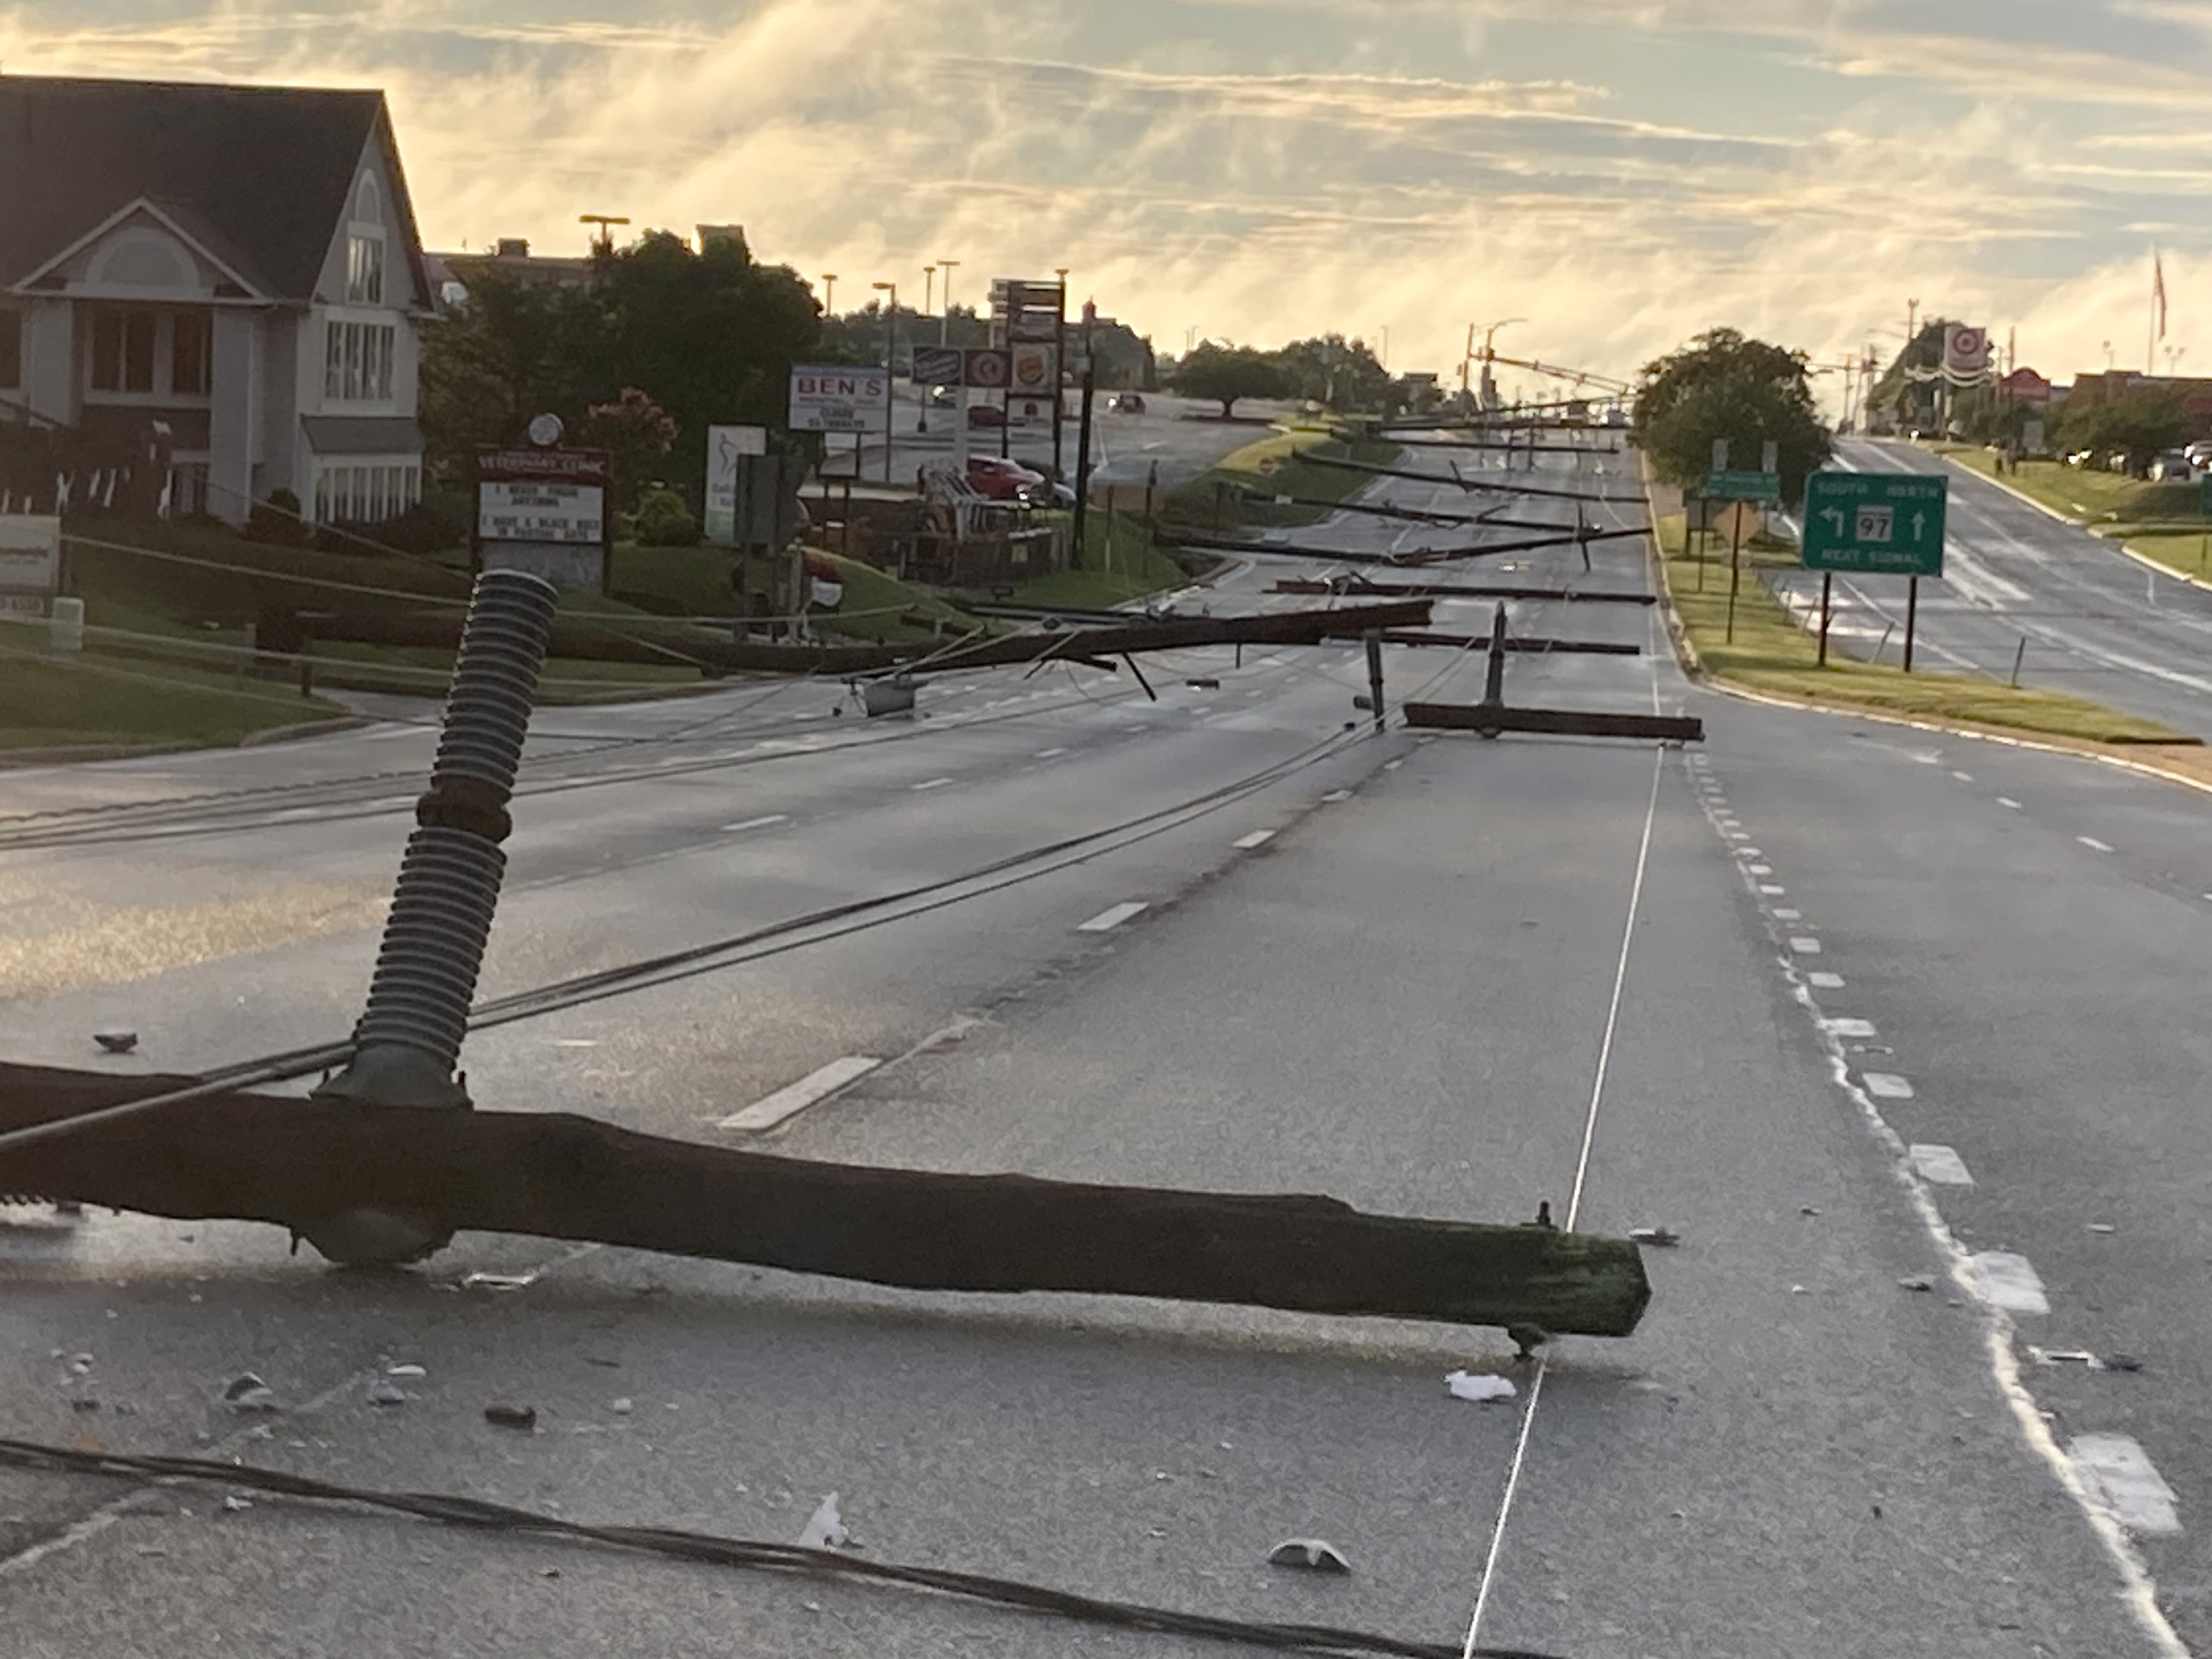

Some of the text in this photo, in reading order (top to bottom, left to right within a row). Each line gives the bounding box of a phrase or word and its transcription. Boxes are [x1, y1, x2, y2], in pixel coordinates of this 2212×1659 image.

[1817, 482, 1938, 497] SOUTH NORTH
[1859, 517, 1889, 539] 97
[1821, 549, 1859, 562] NEXT
